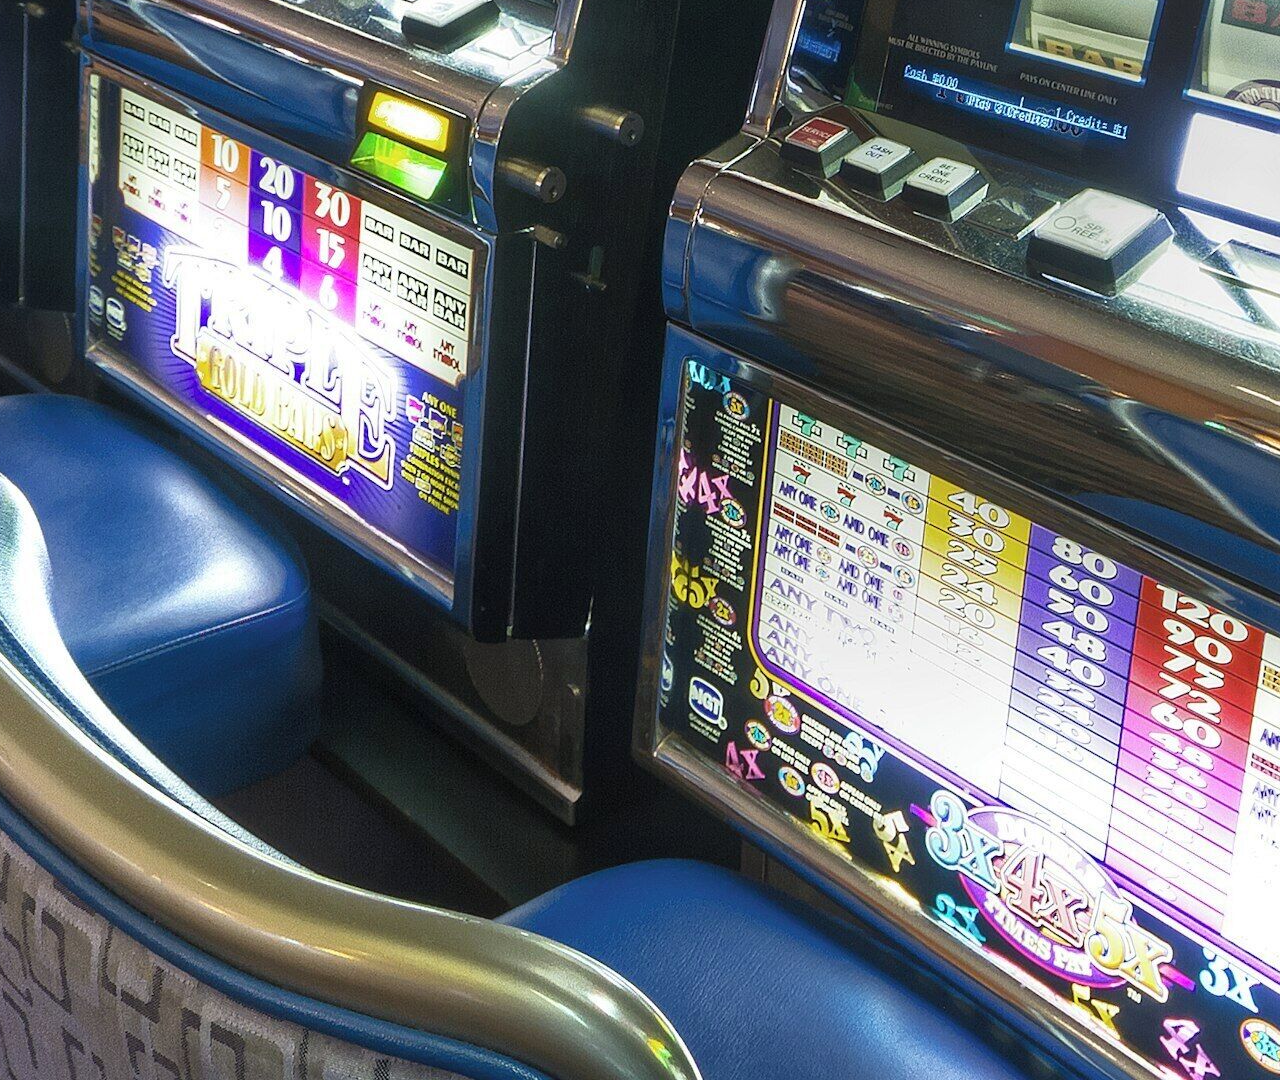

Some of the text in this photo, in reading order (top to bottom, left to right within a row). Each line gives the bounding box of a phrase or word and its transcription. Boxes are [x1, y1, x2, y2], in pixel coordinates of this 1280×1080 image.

[888, 36, 999, 73] MUST BE BISECTED BY THE PAYLINE
[908, 33, 980, 59] ALL WINNING SYMBOLS
[904, 64, 959, 89] Cash $0.00
[1019, 72, 1119, 106] PAYS ON CENTER LINE ONLY
[802, 125, 833, 140] SERVICE
[870, 144, 894, 156] CASH
[865, 150, 884, 160] OUT
[939, 163, 959, 172] BET
[211, 133, 351, 227] 10 20 30
[918, 172, 951, 186] CREDIT
[931, 169, 951, 178] ONE
[216, 176, 346, 269] 5 10 15
[366, 217, 468, 277] BAR BAR BAR
[947, 490, 1249, 643] 40 80 120
[947, 510, 1233, 665] 30 60 90
[946, 539, 1225, 689] 25 50 75
[940, 562, 1222, 725] 24 48 72
[938, 587, 1223, 749] 20 40 60
